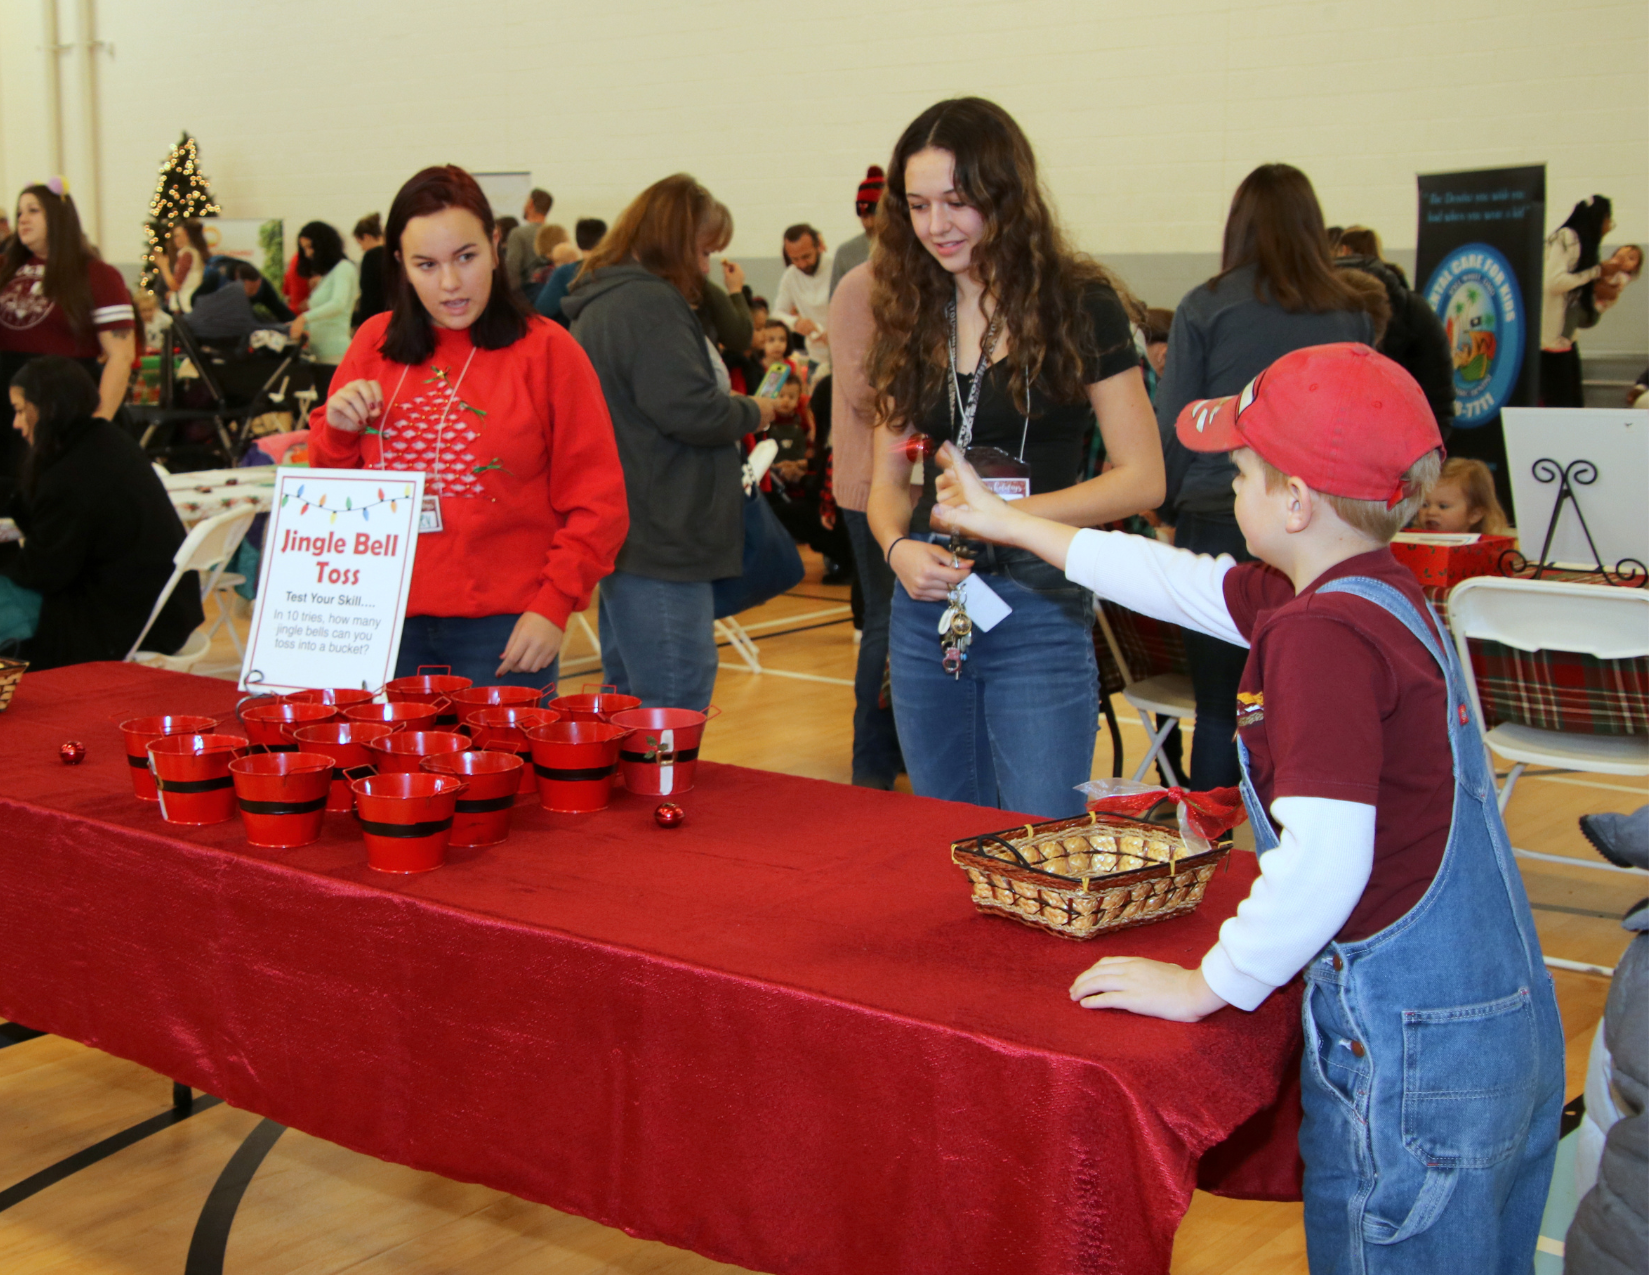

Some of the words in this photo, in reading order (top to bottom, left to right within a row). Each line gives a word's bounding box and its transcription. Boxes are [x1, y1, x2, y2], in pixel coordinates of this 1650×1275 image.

[1429, 270, 1453, 312] ENTAL
[1451, 254, 1484, 275] CARE
[1484, 258, 1505, 286] FOR
[1500, 283, 1516, 322] KIDS
[281, 529, 347, 557] Jingle
[353, 532, 399, 557] Bell
[315, 561, 361, 586] Toss
[286, 591, 308, 603] Test
[311, 593, 335, 605] Your
[273, 609, 283, 619] In
[287, 610, 299, 621] 10
[301, 611, 326, 624] tries,
[328, 613, 350, 625] how
[352, 616, 382, 630] many
[276, 624, 303, 637] jingle
[305, 626, 329, 638] bells
[332, 629, 351, 639] can
[354, 631, 373, 643] you
[274, 638, 295, 649] toss
[298, 640, 317, 652] into
[319, 643, 326, 652] a
[328, 642, 370, 655] bucket?
